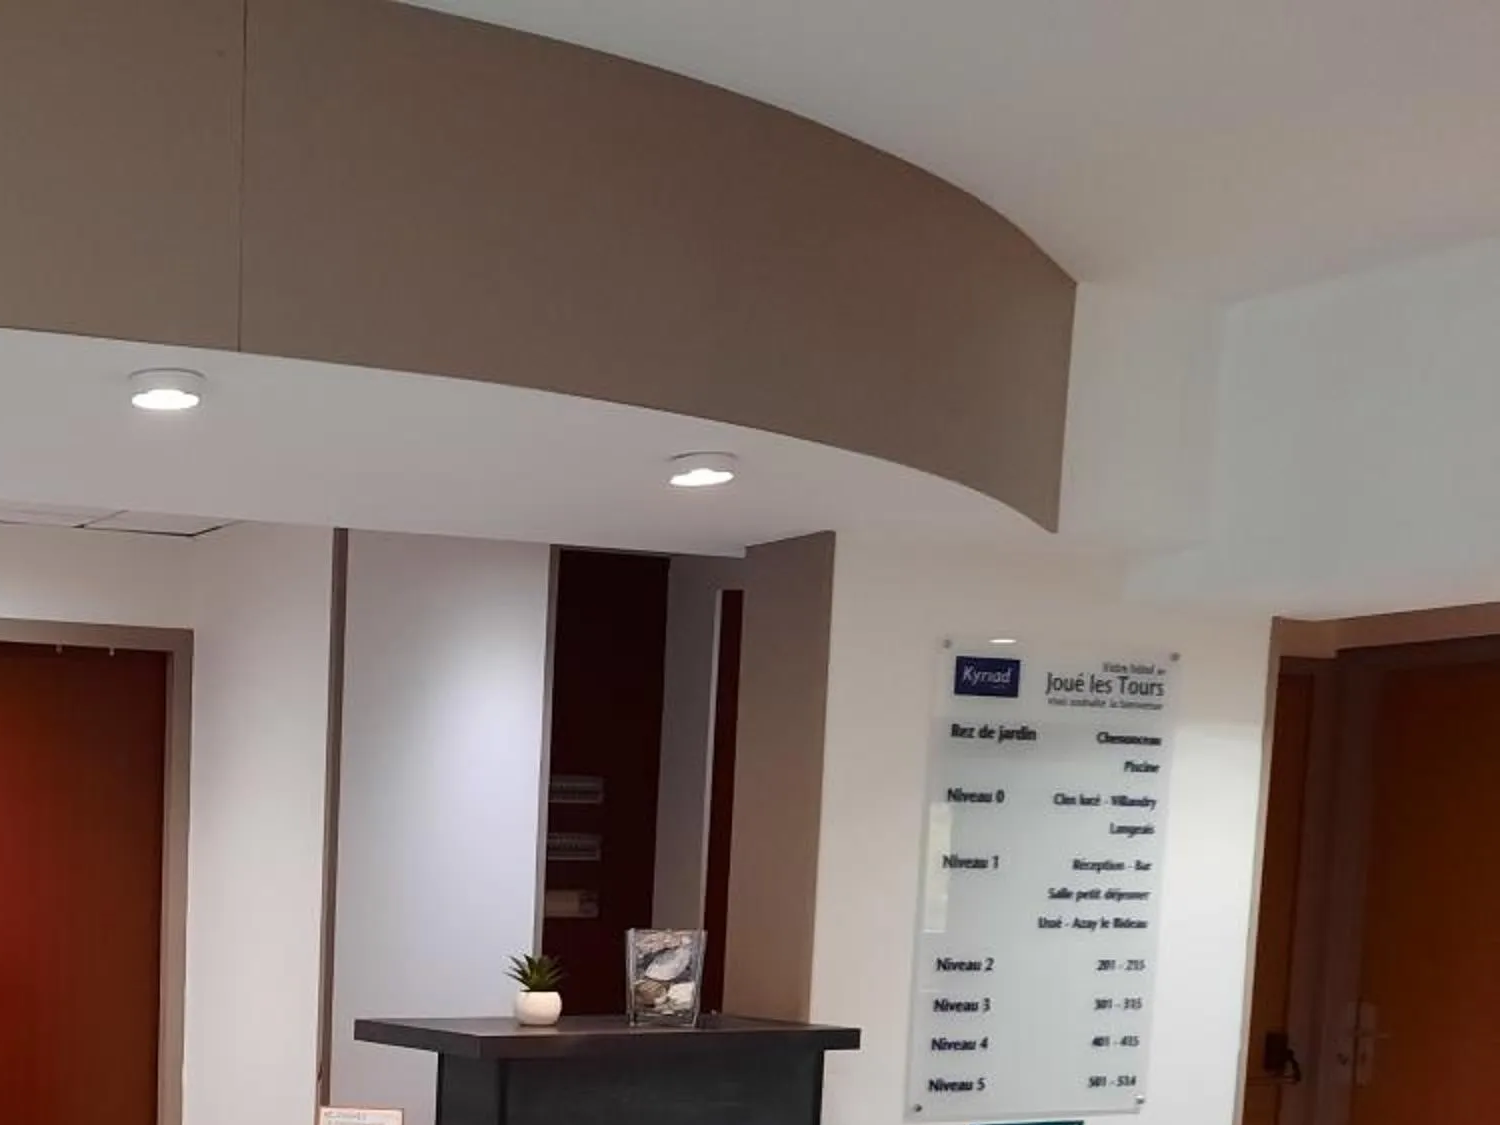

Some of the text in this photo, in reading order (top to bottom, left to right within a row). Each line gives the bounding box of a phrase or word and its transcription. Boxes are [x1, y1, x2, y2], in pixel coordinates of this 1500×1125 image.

[963, 665, 1012, 686] Kyriad
[1045, 672, 1165, 696] Joué les Tours
[951, 724, 1037, 744] Rez de jardin
[947, 787, 1005, 804] Niveau 0
[942, 855, 999, 869] Niveau 1
[1135, 860, 1152, 871] Bar
[1048, 887, 1072, 900] Salle
[1076, 888, 1101, 902] petit
[1072, 917, 1098, 931] Azay
[1100, 916, 1109, 928] le
[1112, 917, 1148, 929] Rideau
[936, 957, 994, 973] Niveau 2
[933, 997, 990, 1013] Niveau 3
[931, 1037, 988, 1051] Niveau 4
[928, 1078, 985, 1092] Niveau 5
